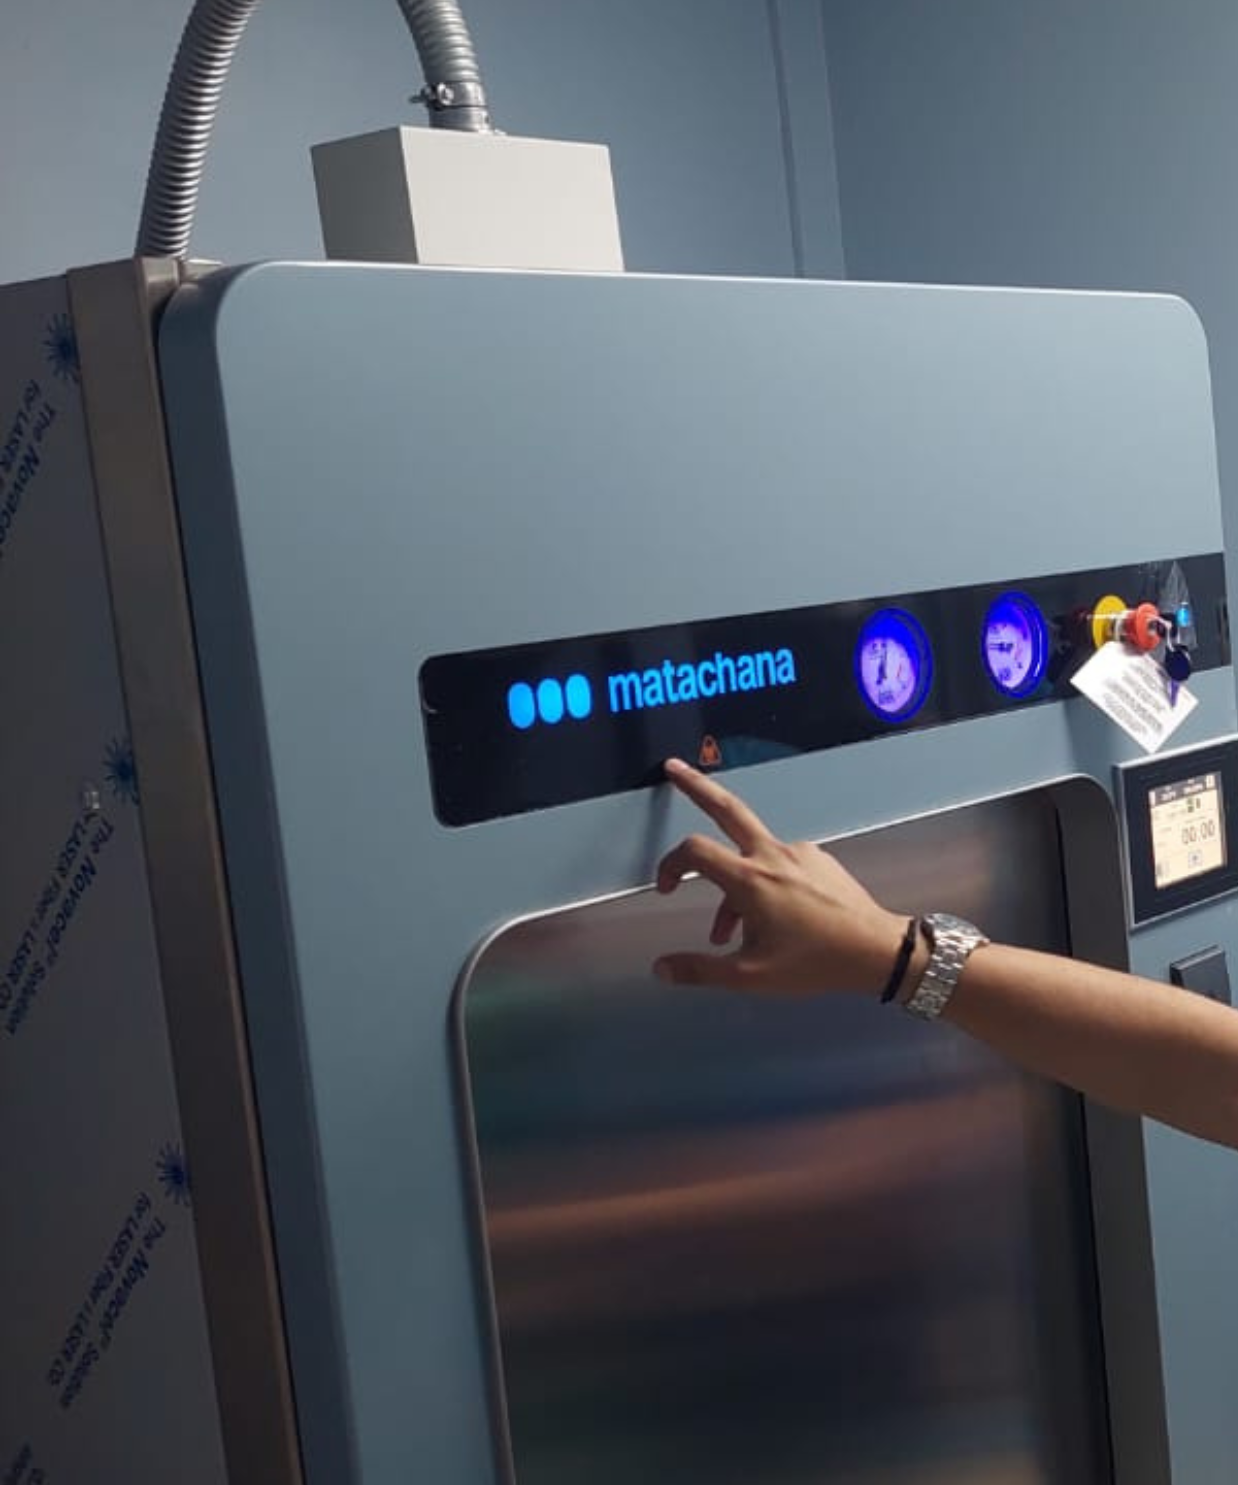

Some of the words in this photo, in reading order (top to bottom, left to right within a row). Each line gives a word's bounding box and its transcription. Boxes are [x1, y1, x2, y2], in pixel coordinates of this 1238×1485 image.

[24, 378, 42, 412] for
[33, 401, 55, 440] The
[608, 648, 796, 713] matachana
[90, 816, 114, 854] The
[143, 1217, 166, 1250] The
